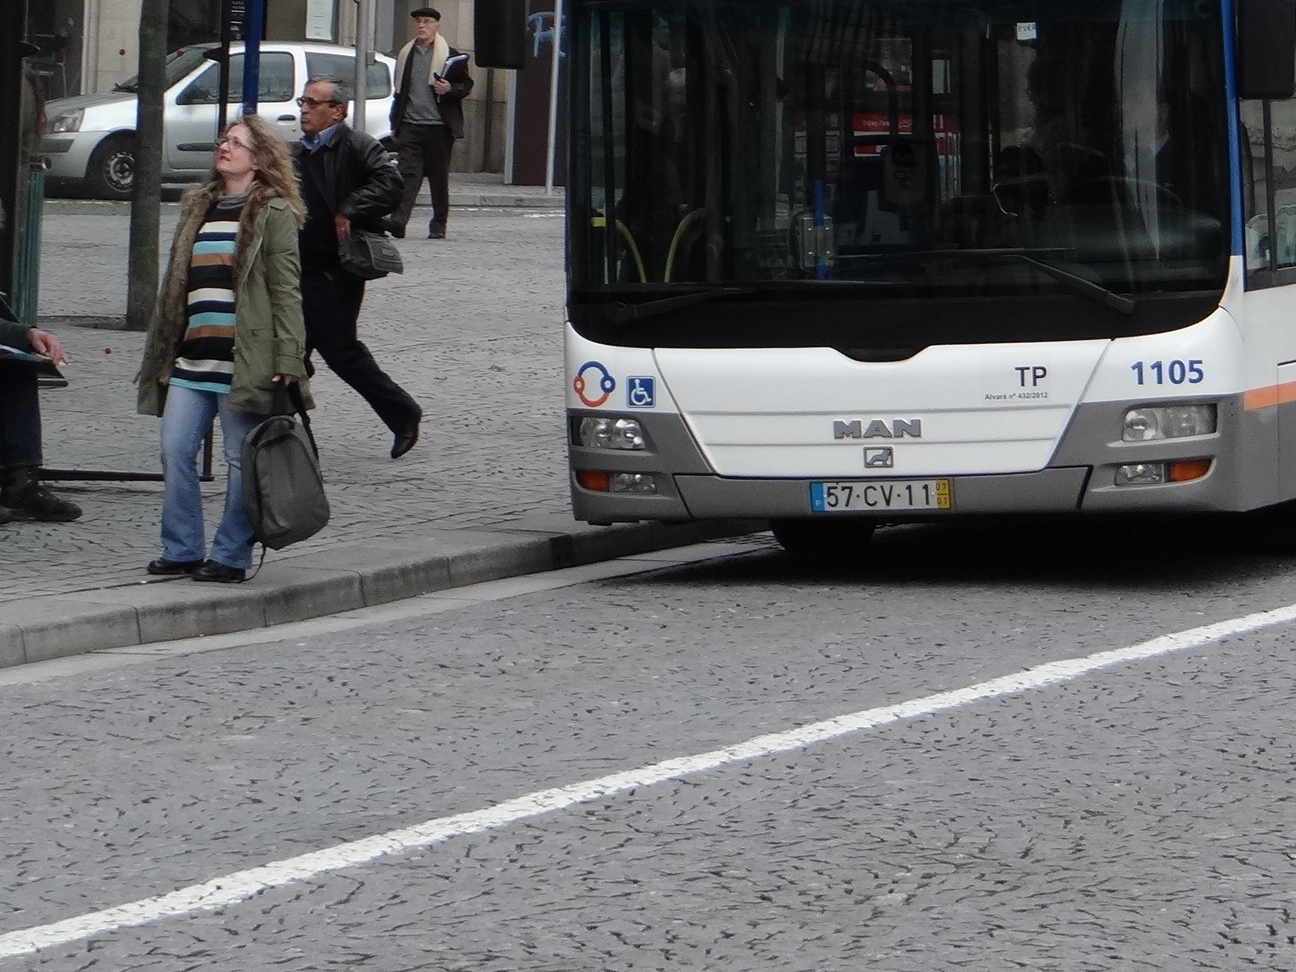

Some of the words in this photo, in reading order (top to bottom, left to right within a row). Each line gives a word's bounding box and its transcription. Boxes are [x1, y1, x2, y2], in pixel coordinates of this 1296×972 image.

[1014, 365, 1048, 387] TP
[1130, 359, 1205, 386] 1105
[1017, 391, 1048, 399] 432/2012
[833, 419, 922, 439] MAN
